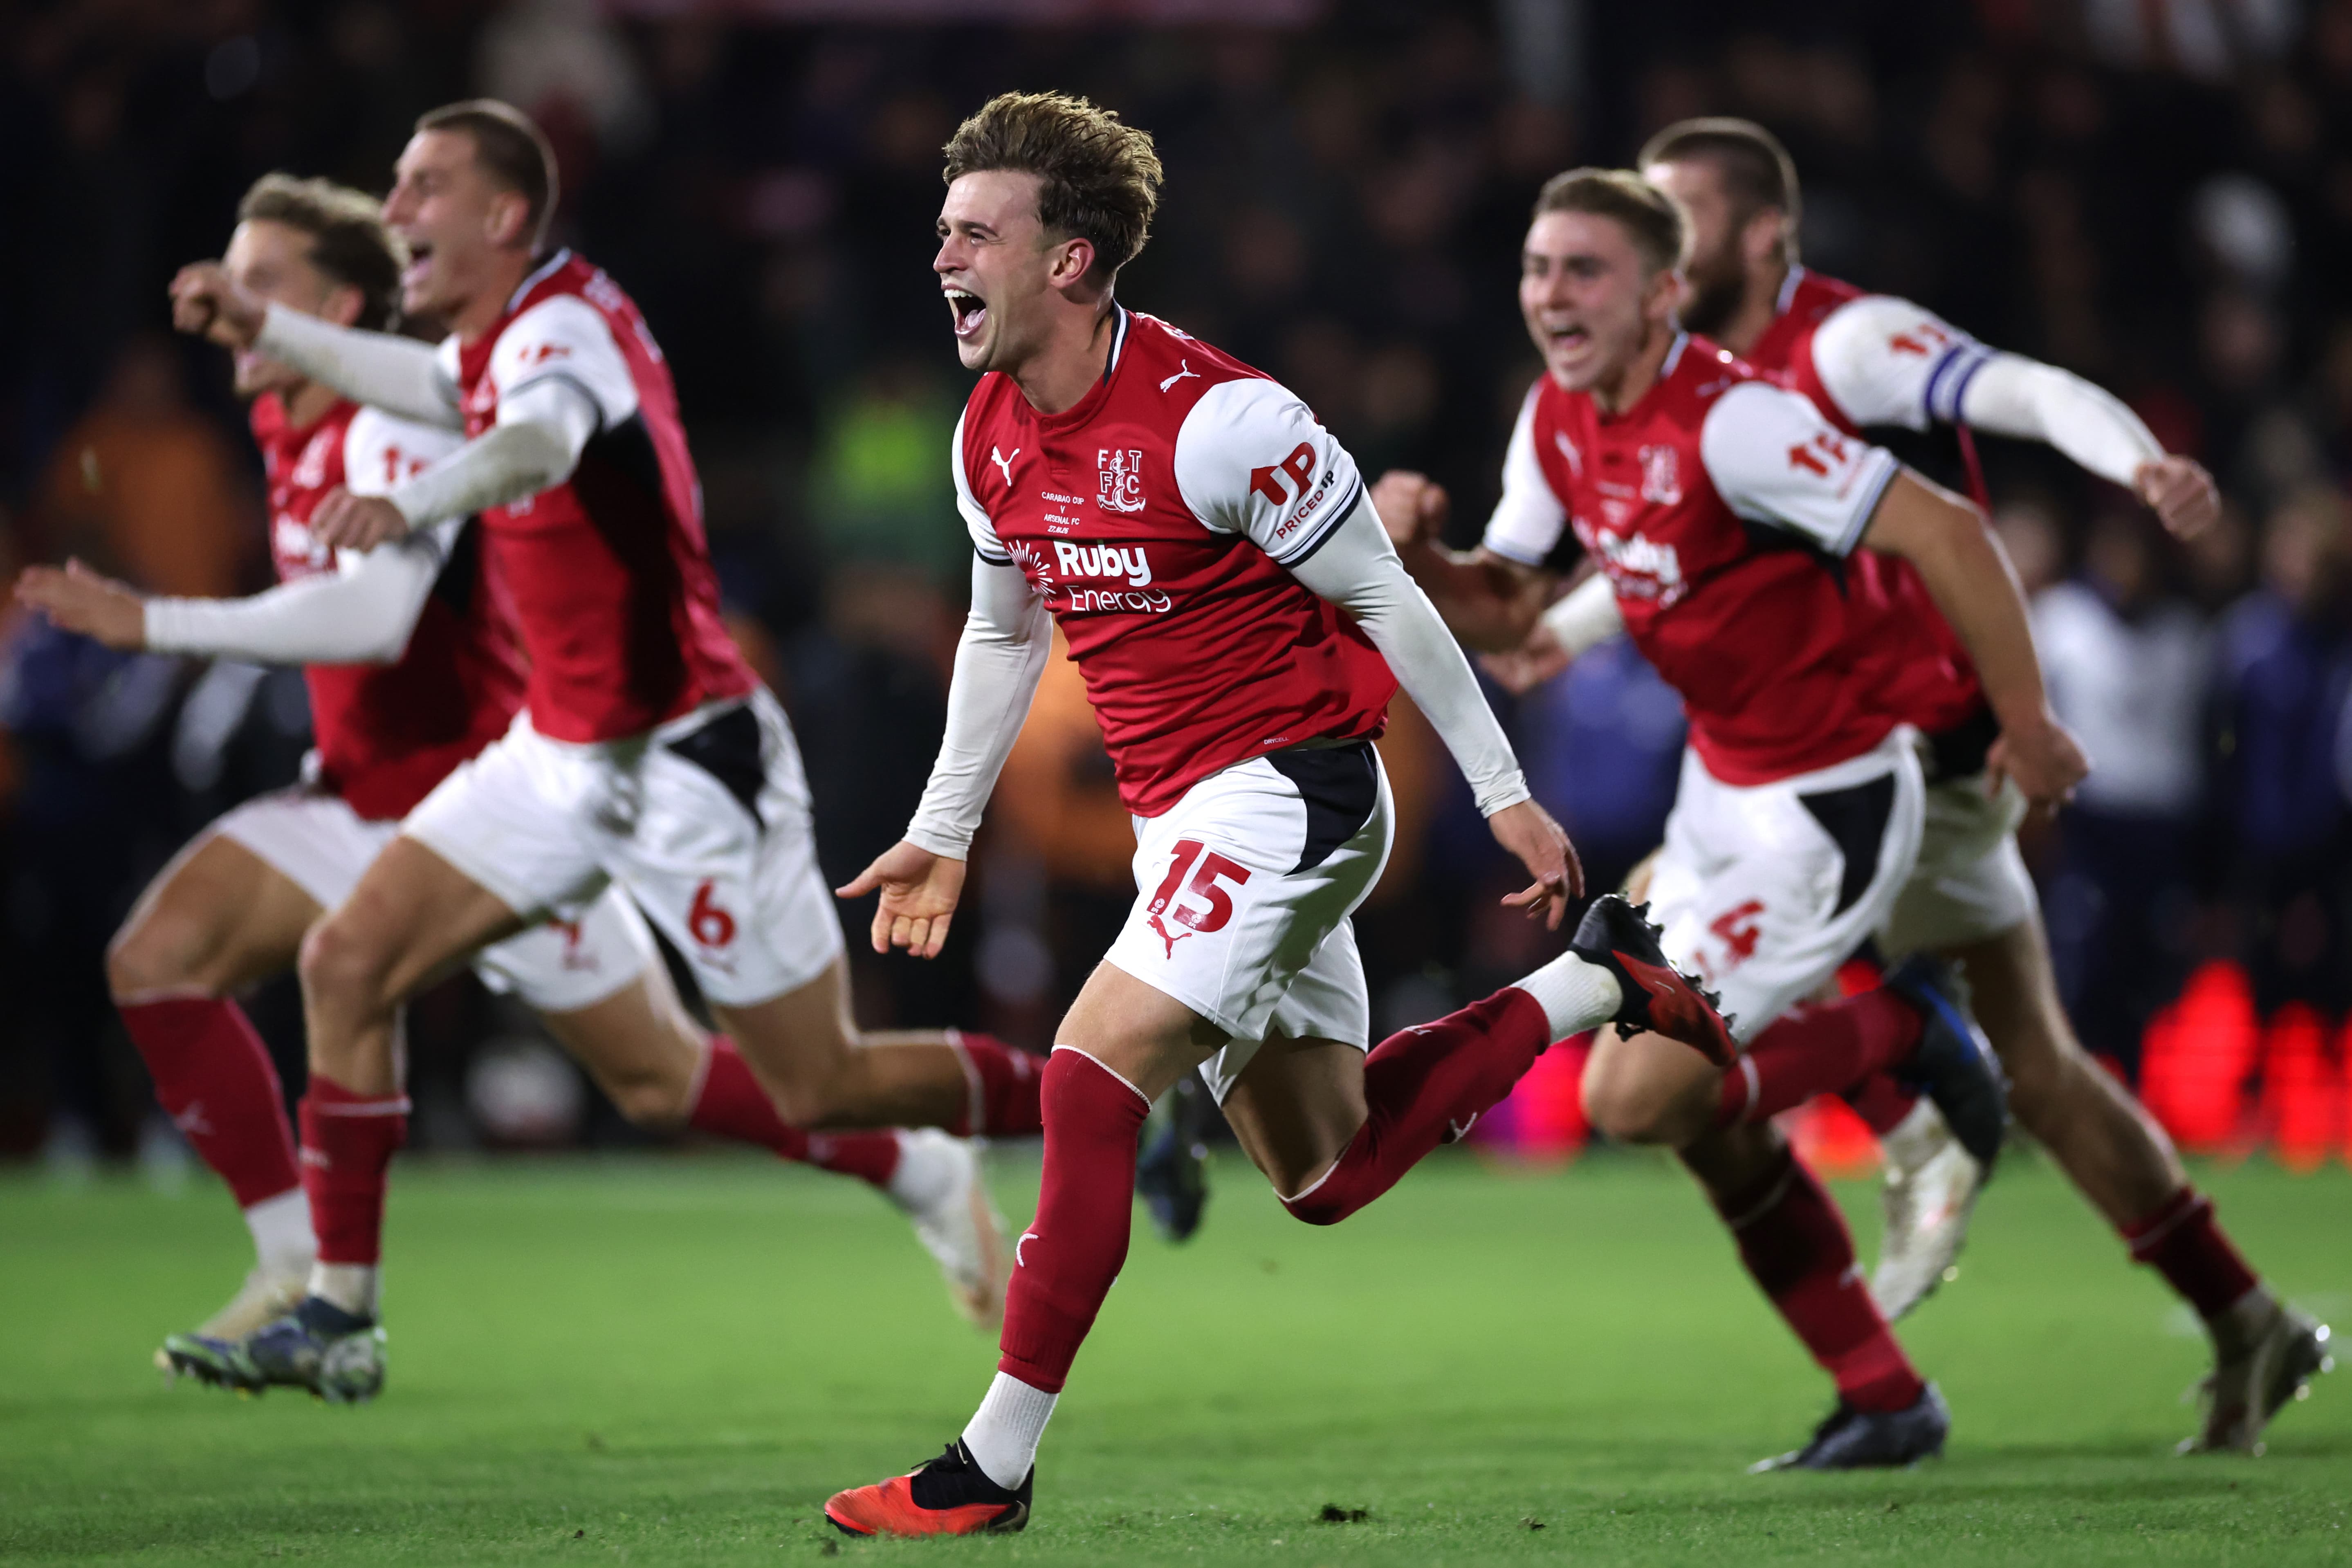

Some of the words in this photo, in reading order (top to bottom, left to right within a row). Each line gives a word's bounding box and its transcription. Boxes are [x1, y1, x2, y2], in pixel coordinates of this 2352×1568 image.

[1041, 491, 1071, 503] CARABAO
[1073, 496, 1084, 505] CUP
[1060, 505, 1066, 514] V
[1276, 490, 1324, 539] PRICED
[1321, 470, 1334, 488] UP
[1044, 514, 1070, 525] ARSENAL
[1053, 539, 1152, 587] Ruby
[1064, 585, 1172, 612] Energy
[1146, 839, 1252, 933] 15
[687, 875, 737, 949] 6
